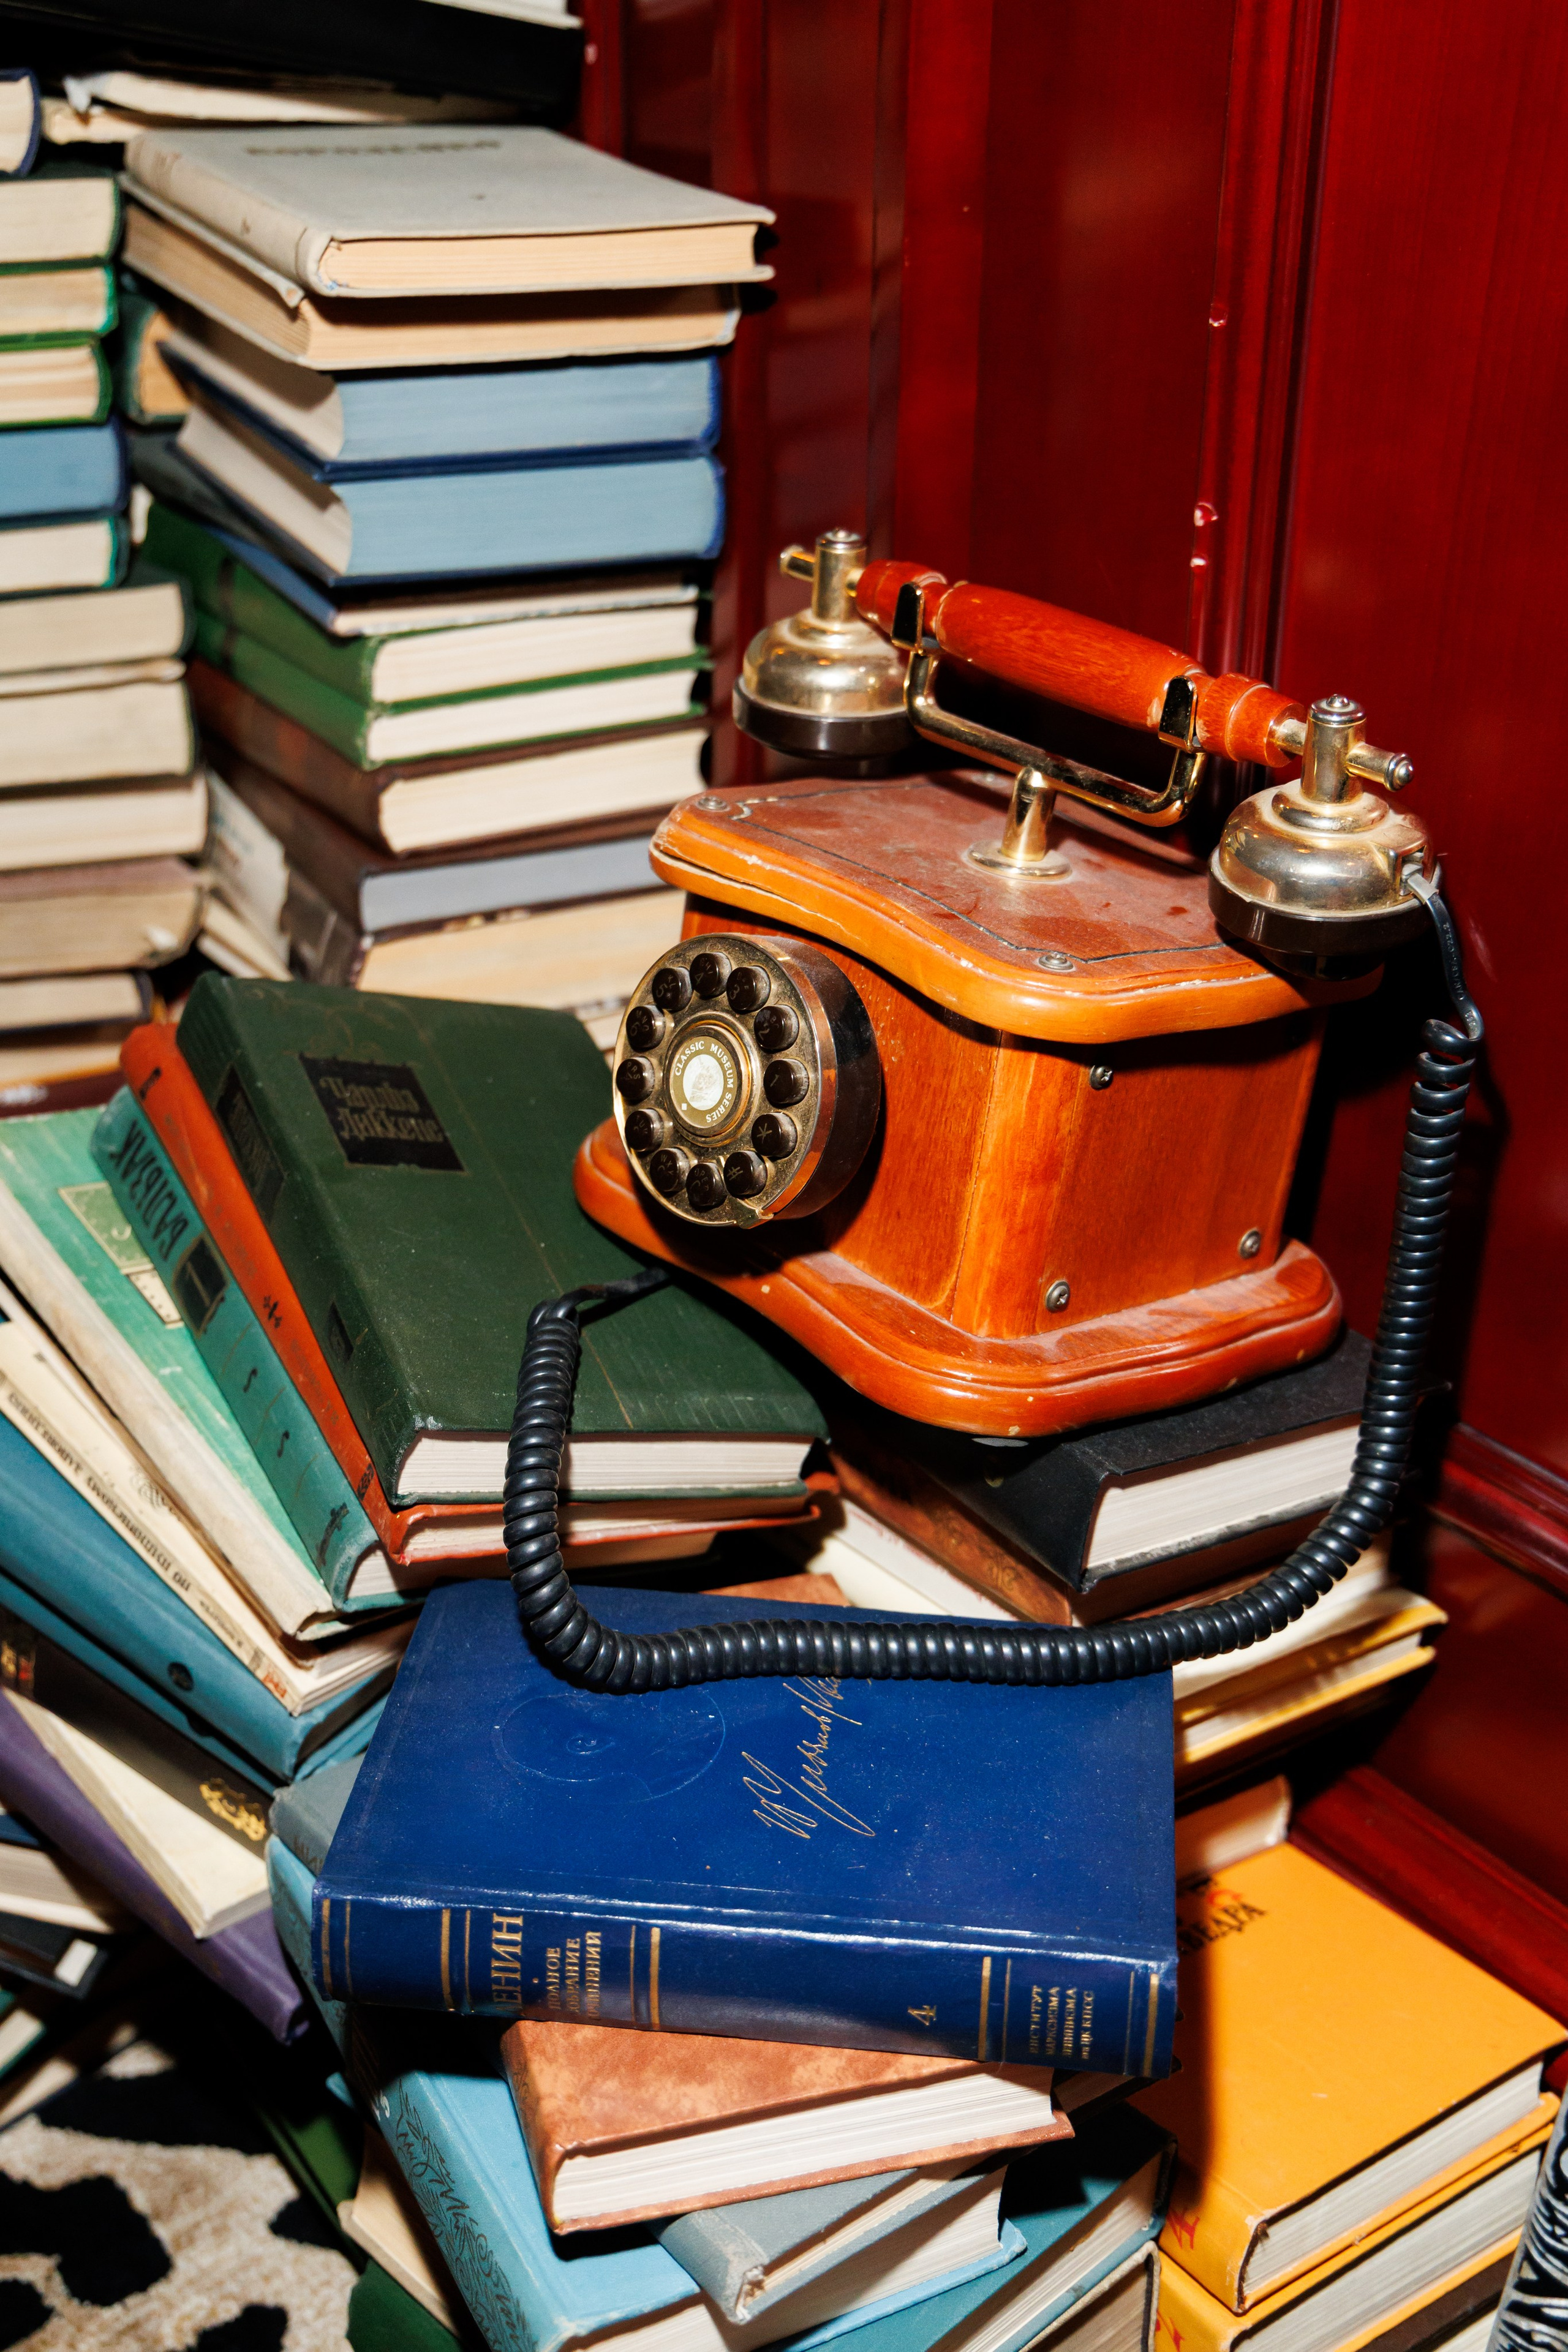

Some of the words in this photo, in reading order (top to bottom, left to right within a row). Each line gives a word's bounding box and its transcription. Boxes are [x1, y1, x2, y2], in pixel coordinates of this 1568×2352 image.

[675, 1041, 704, 1076] CLASSIC
[710, 1043, 734, 1088] MUSEUM
[706, 1092, 732, 1123] SERIES
[109, 1118, 189, 1261] БАЛЬЗАК
[546, 1947, 561, 2010] ПОЛНОЕ
[908, 2005, 937, 2026] 4
